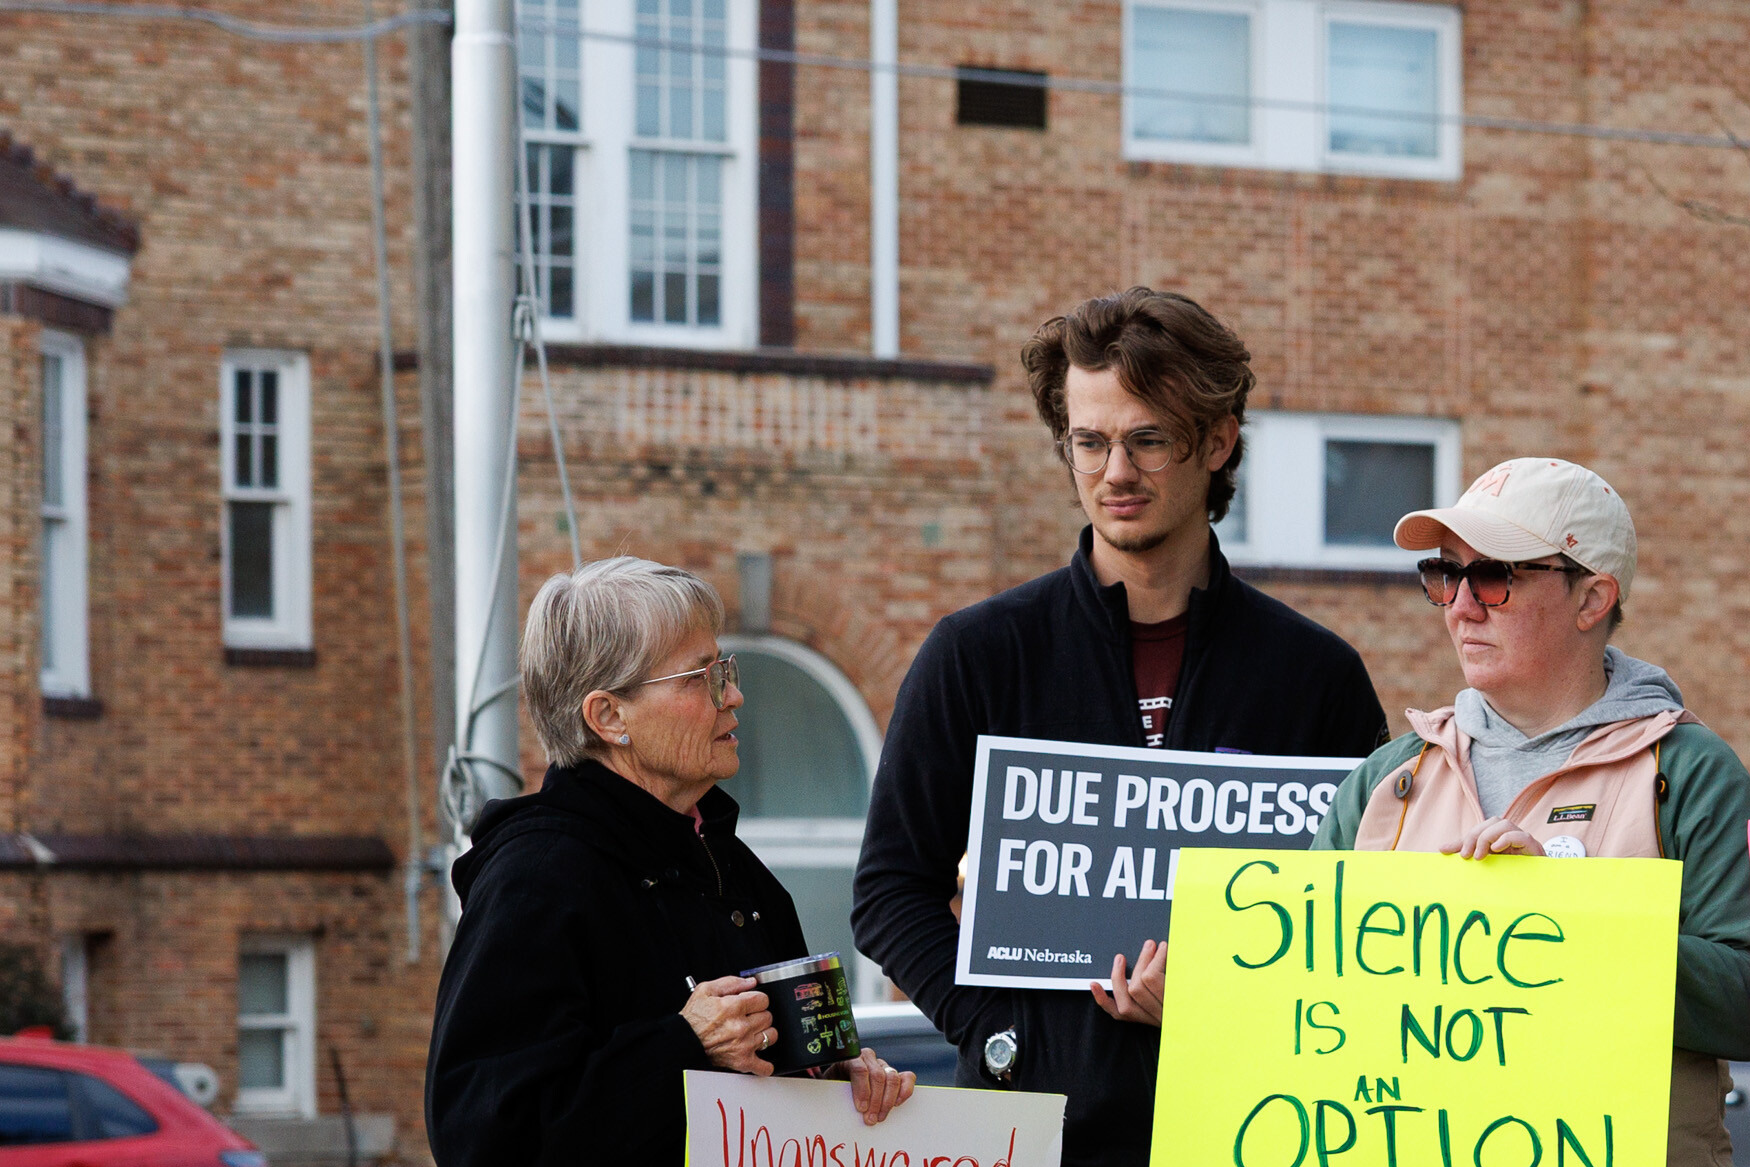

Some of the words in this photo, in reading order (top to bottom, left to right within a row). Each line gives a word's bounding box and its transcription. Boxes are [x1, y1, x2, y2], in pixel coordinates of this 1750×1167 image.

[1002, 766, 1102, 826] DUE
[1113, 774, 1338, 835] PROCESS
[996, 838, 1092, 897] FOR
[987, 946, 1022, 960] ACLU
[1023, 948, 1092, 964] Nebraska
[1225, 860, 1565, 989] Silence
[1294, 998, 1347, 1056] IS
[1400, 1003, 1533, 1067] NOT
[1354, 1074, 1401, 1104] AN
